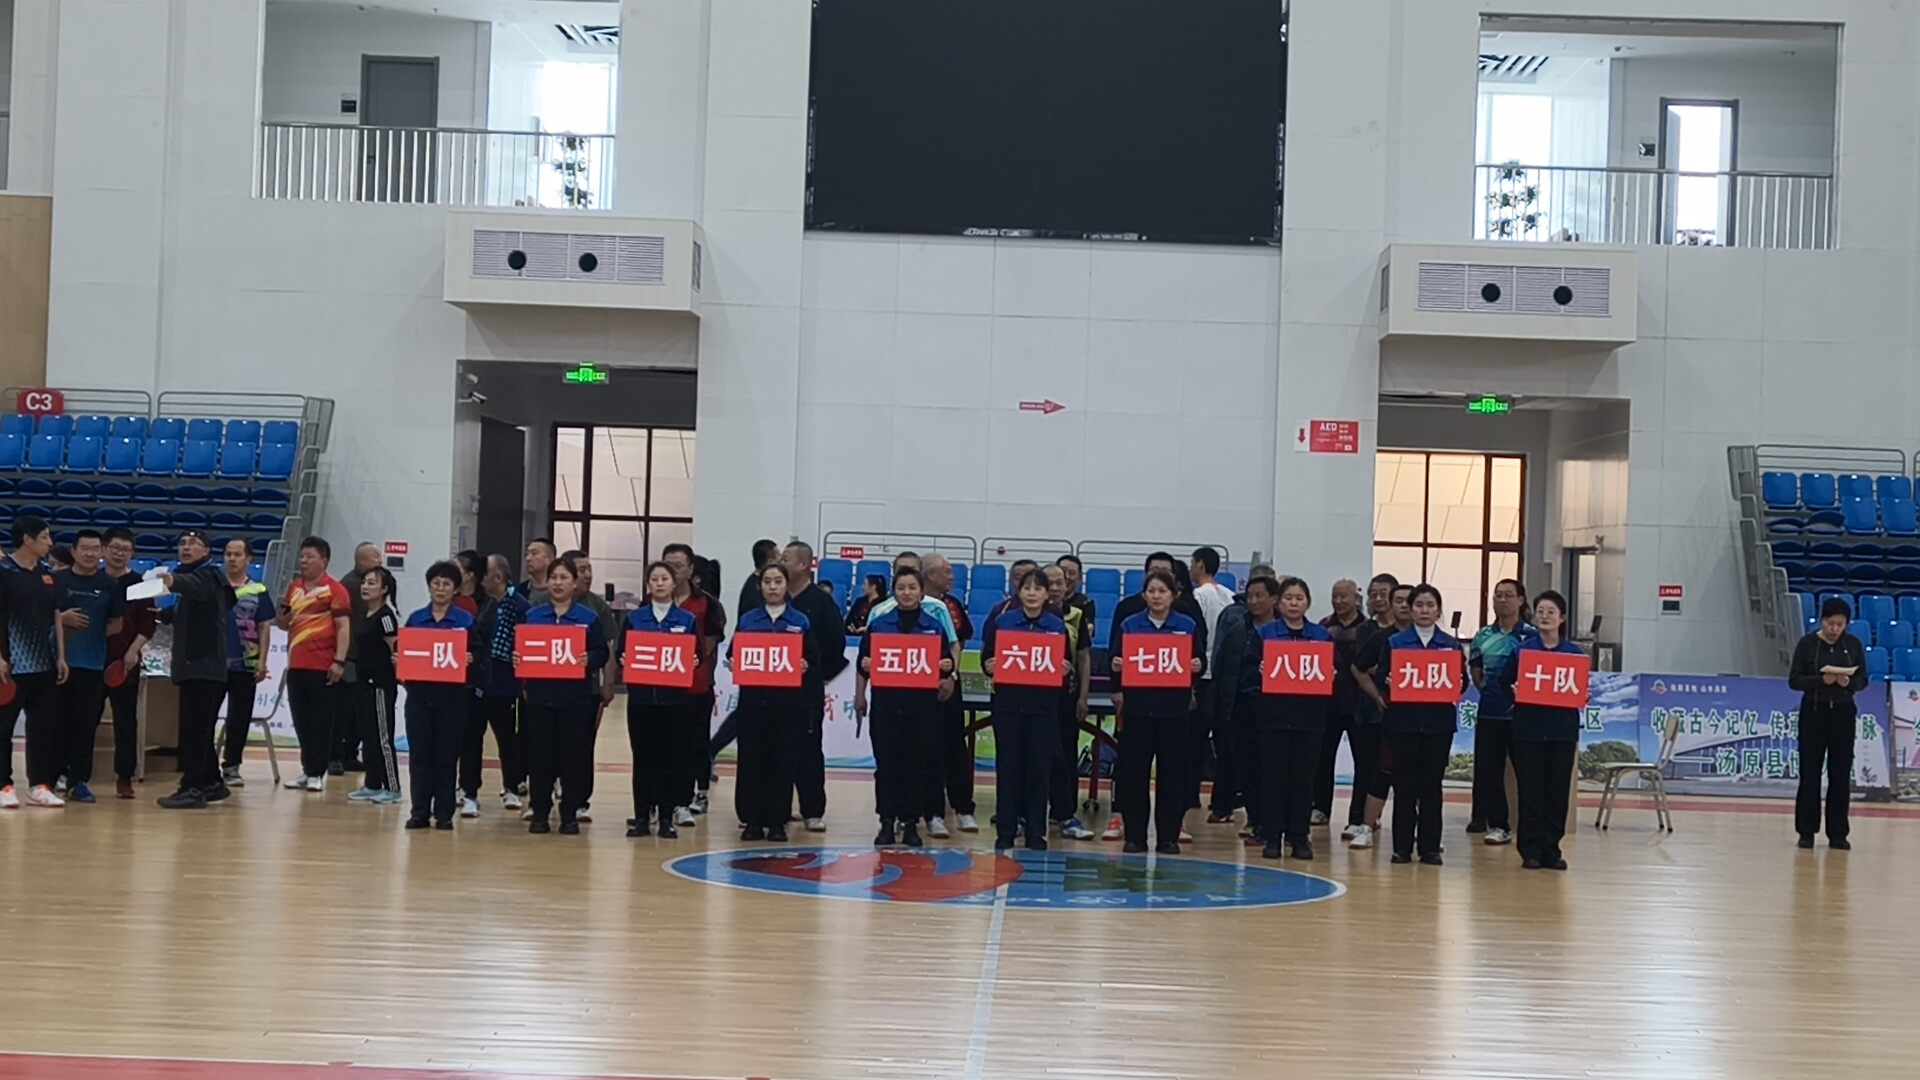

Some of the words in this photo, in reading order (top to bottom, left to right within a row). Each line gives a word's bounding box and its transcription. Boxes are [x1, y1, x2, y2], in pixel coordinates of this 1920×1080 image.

[26, 392, 52, 411] C3
[404, 641, 459, 670] 一队
[522, 638, 577, 665] 二队
[631, 645, 686, 673] 三队
[740, 646, 794, 673] 四队
[877, 647, 932, 675] 五队
[1002, 645, 1056, 673] 六队
[1129, 647, 1184, 674] 七队
[1271, 654, 1325, 682] 八队
[1398, 662, 1453, 689] 九队
[1525, 664, 1580, 694] 十队
